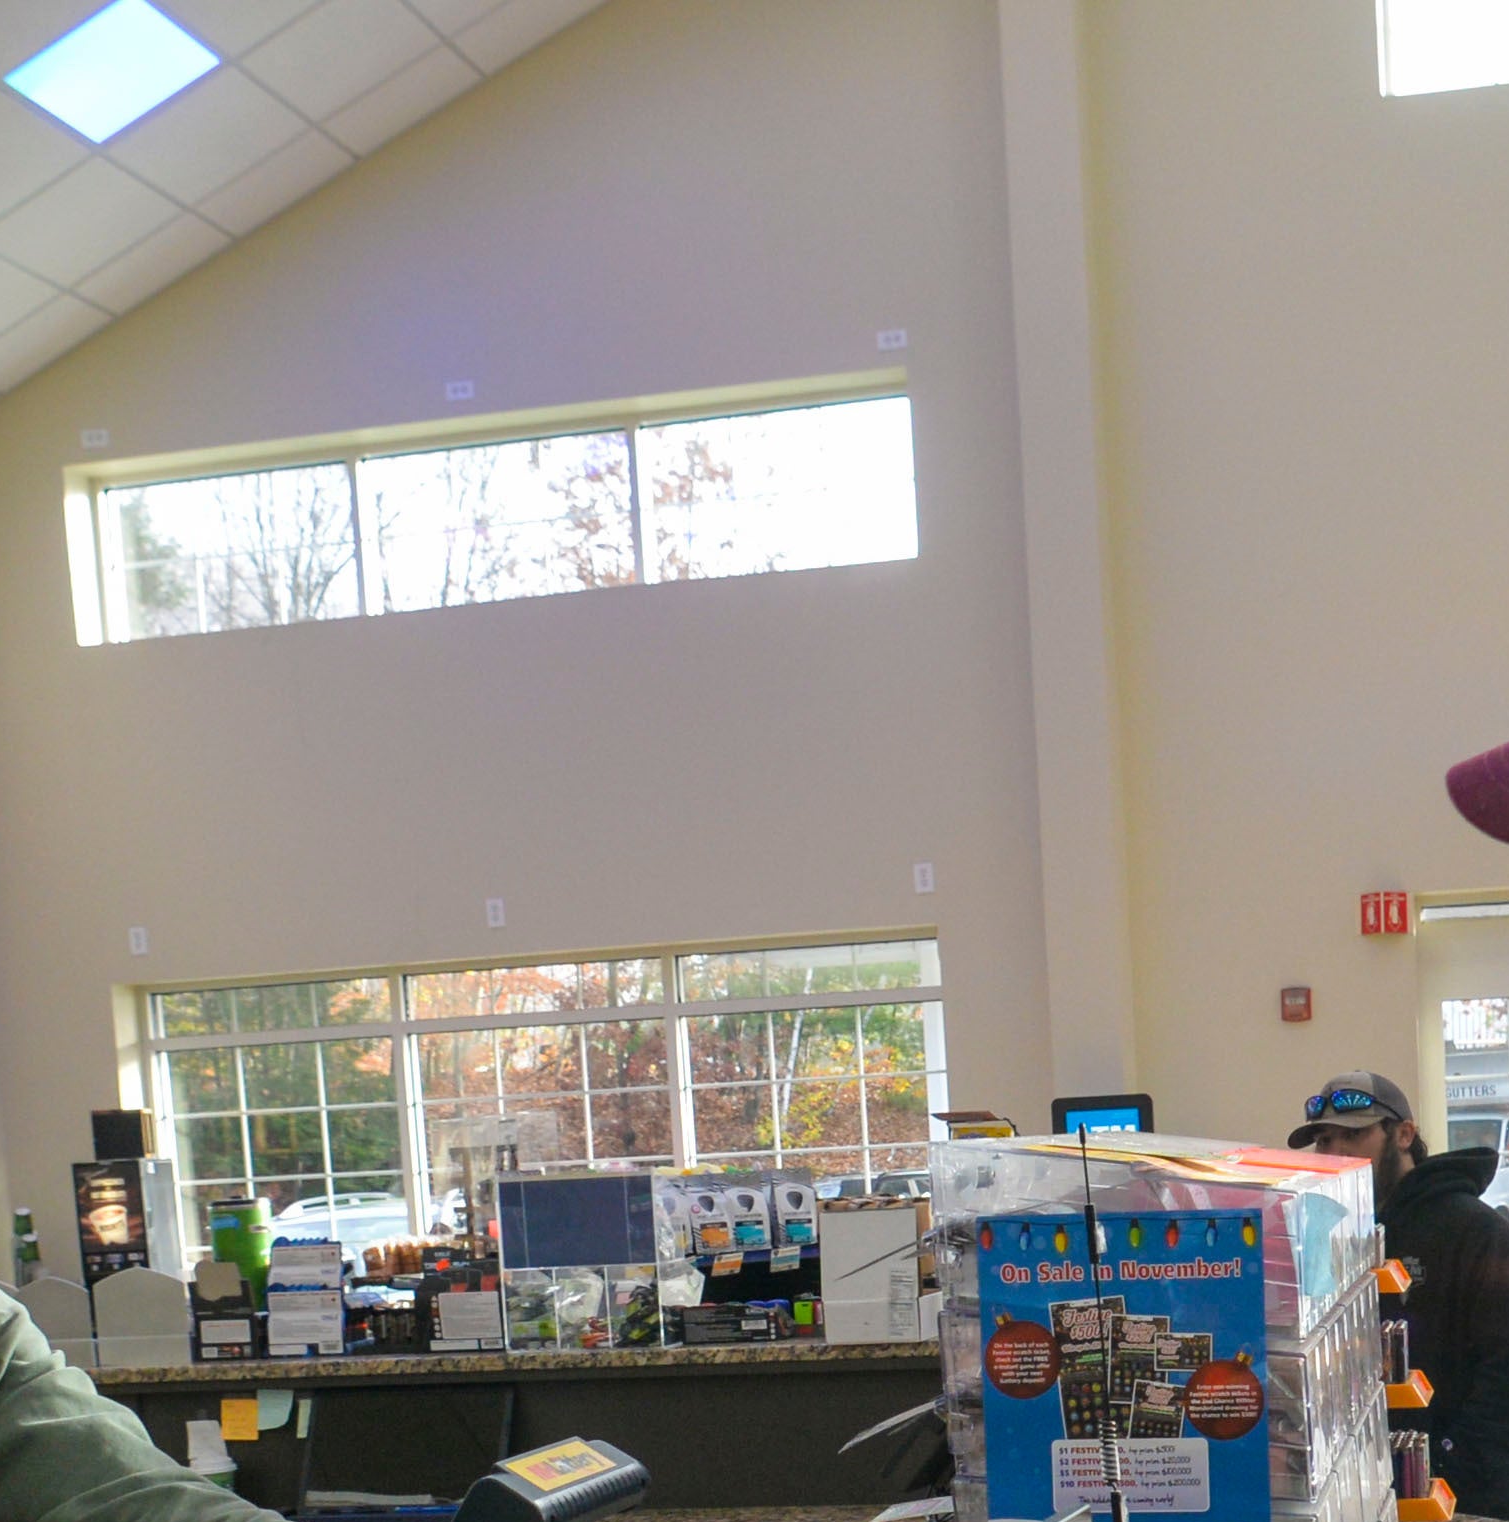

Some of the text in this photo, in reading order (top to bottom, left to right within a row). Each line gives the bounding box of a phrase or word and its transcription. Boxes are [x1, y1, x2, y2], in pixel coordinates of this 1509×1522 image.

[1445, 1083, 1497, 1100] GUTTERS
[1000, 1263, 1030, 1283] On
[1038, 1261, 1084, 1283] Sale
[1120, 1256, 1242, 1281] November!
[1077, 1480, 1108, 1488] FESTIV
